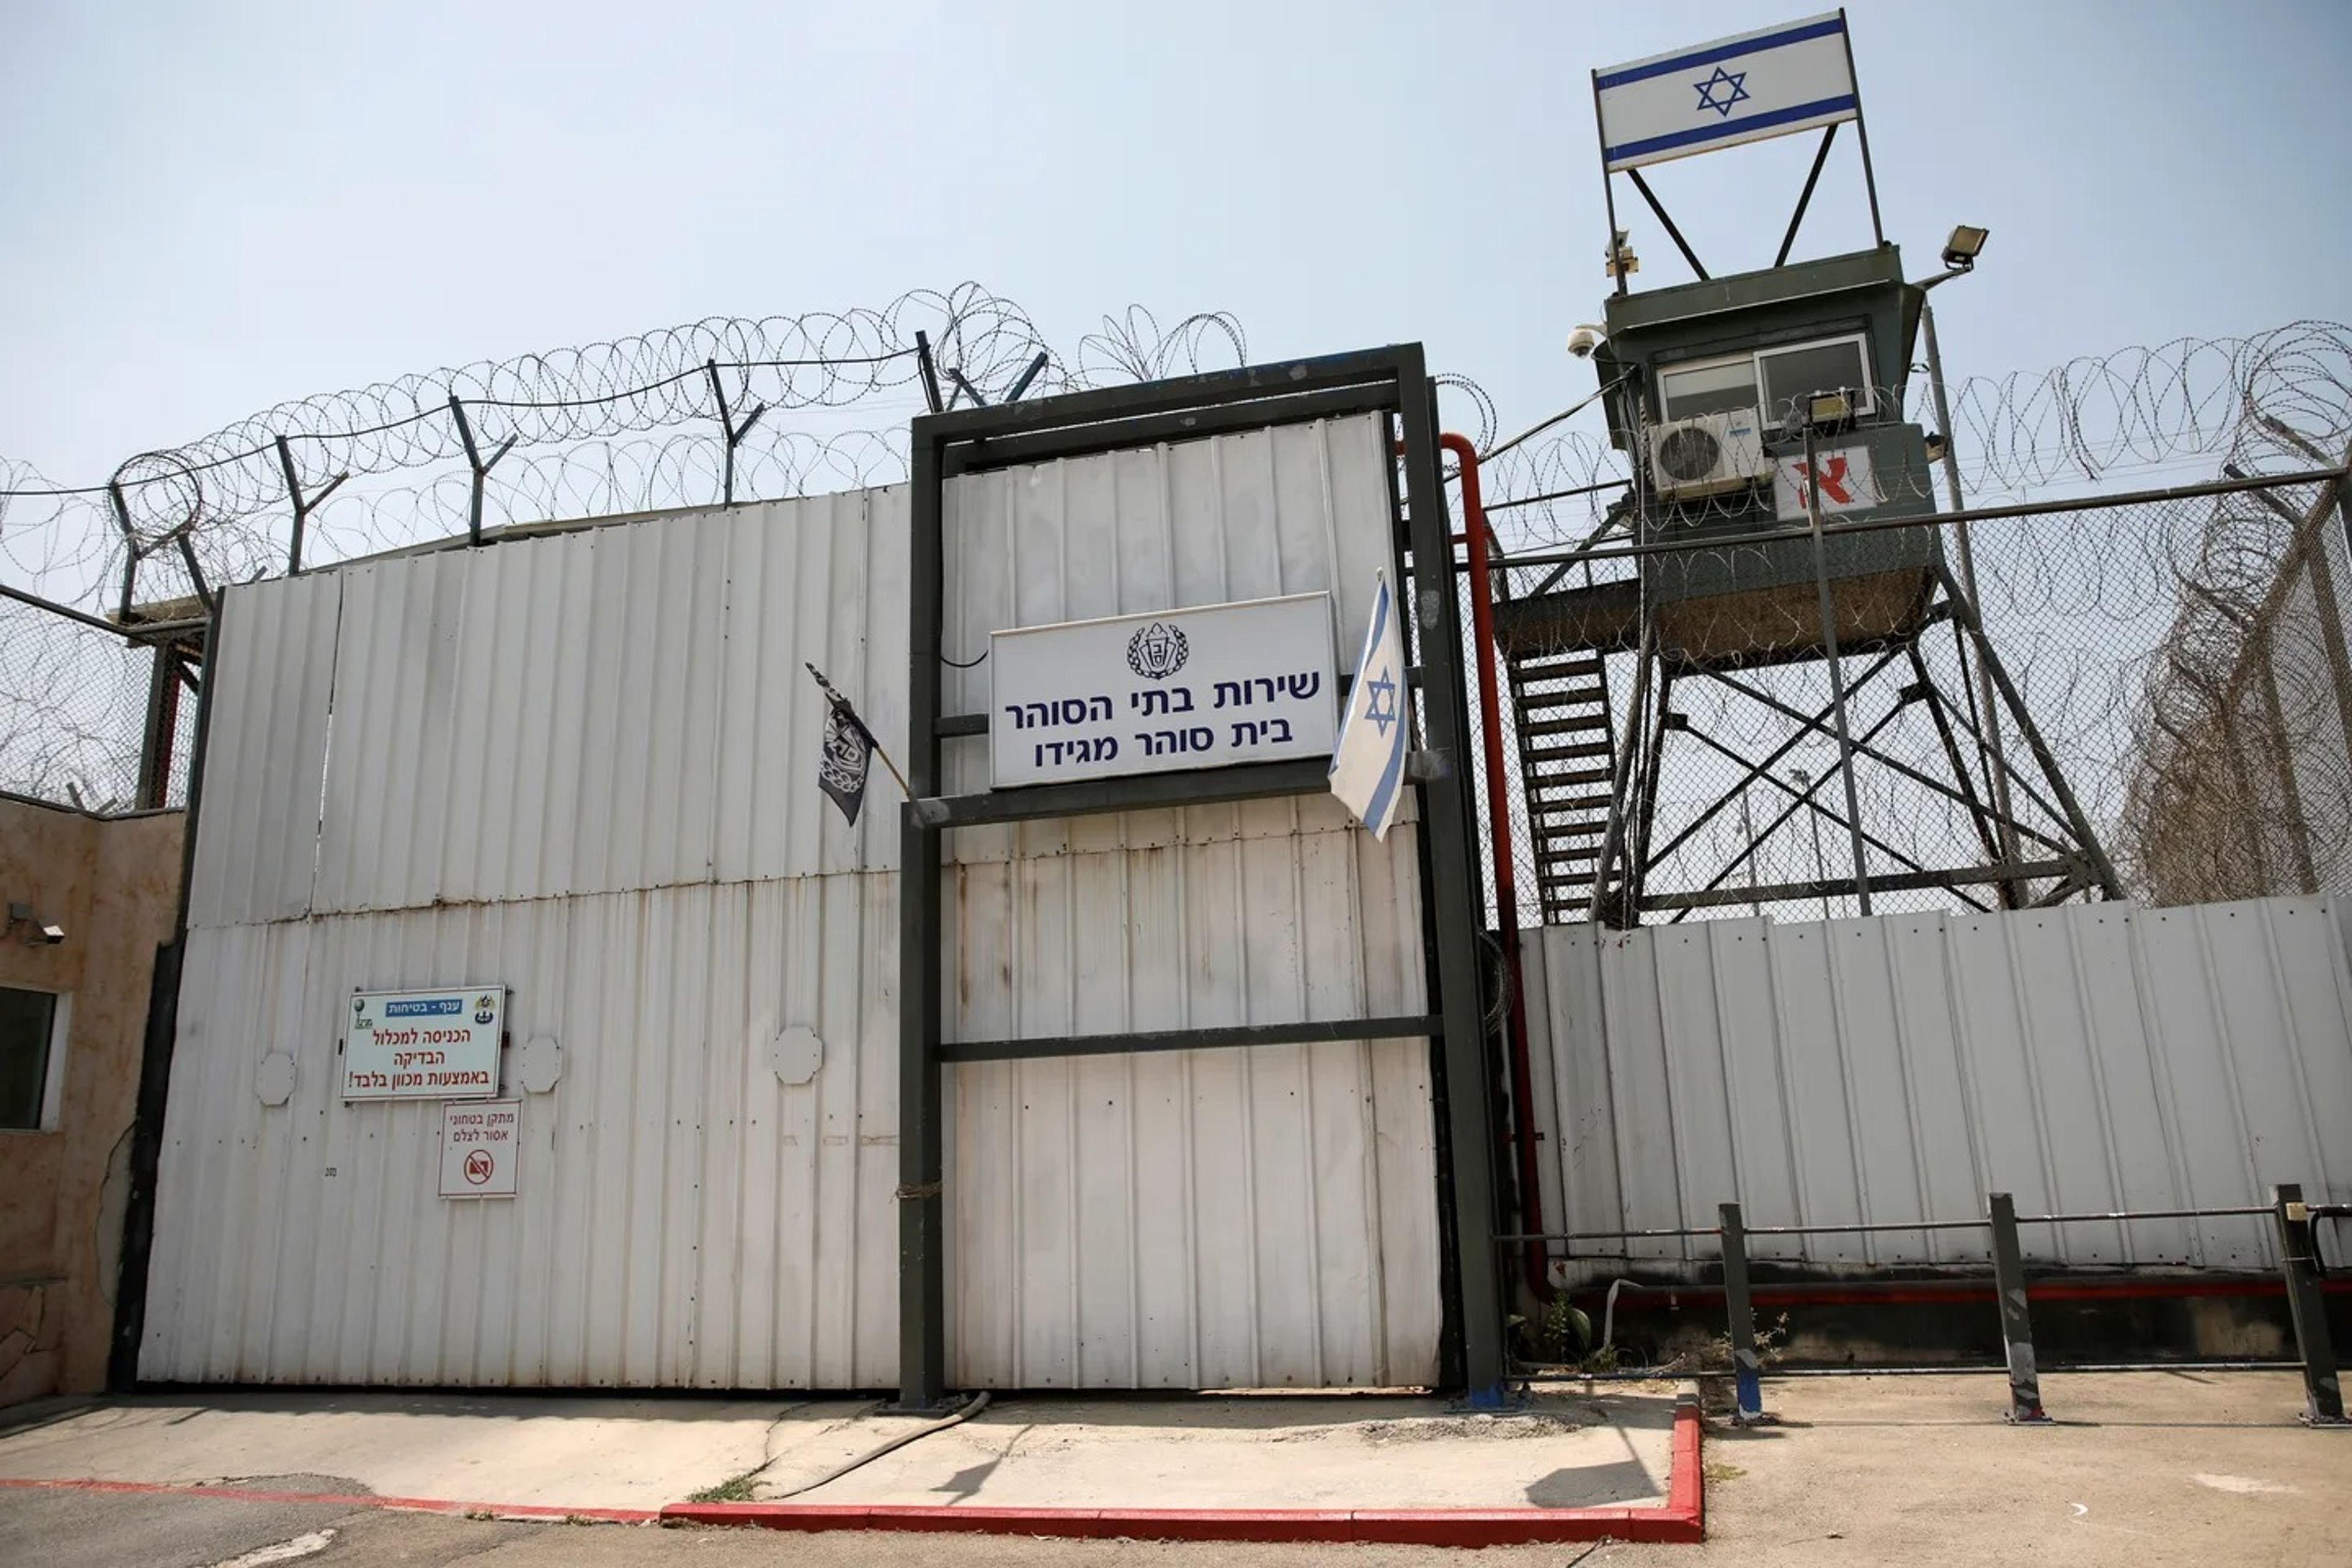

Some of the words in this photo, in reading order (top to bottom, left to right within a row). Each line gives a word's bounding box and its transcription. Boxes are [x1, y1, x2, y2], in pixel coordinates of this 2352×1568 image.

[1213, 671, 1320, 709] שירות
[1131, 687, 1194, 717] בתי
[1005, 695, 1114, 729] הסוהר
[1134, 726, 1215, 756] סוהר
[1231, 718, 1293, 747] בית
[1035, 736, 1118, 767] מגידו
[388, 1002, 428, 1015] בטיחות
[439, 1001, 460, 1014] ענף
[372, 1027, 418, 1046] למכלול
[422, 1029, 471, 1044] הכניסה
[393, 1050, 445, 1069] הבדיקה
[349, 1069, 388, 1088] בלבד!
[391, 1073, 423, 1091] מכוון
[427, 1071, 489, 1087] באמצעות
[450, 1114, 483, 1126] בטחוני
[486, 1114, 514, 1127] מתקן
[453, 1128, 480, 1142] לצלם
[483, 1129, 509, 1141] אסור
